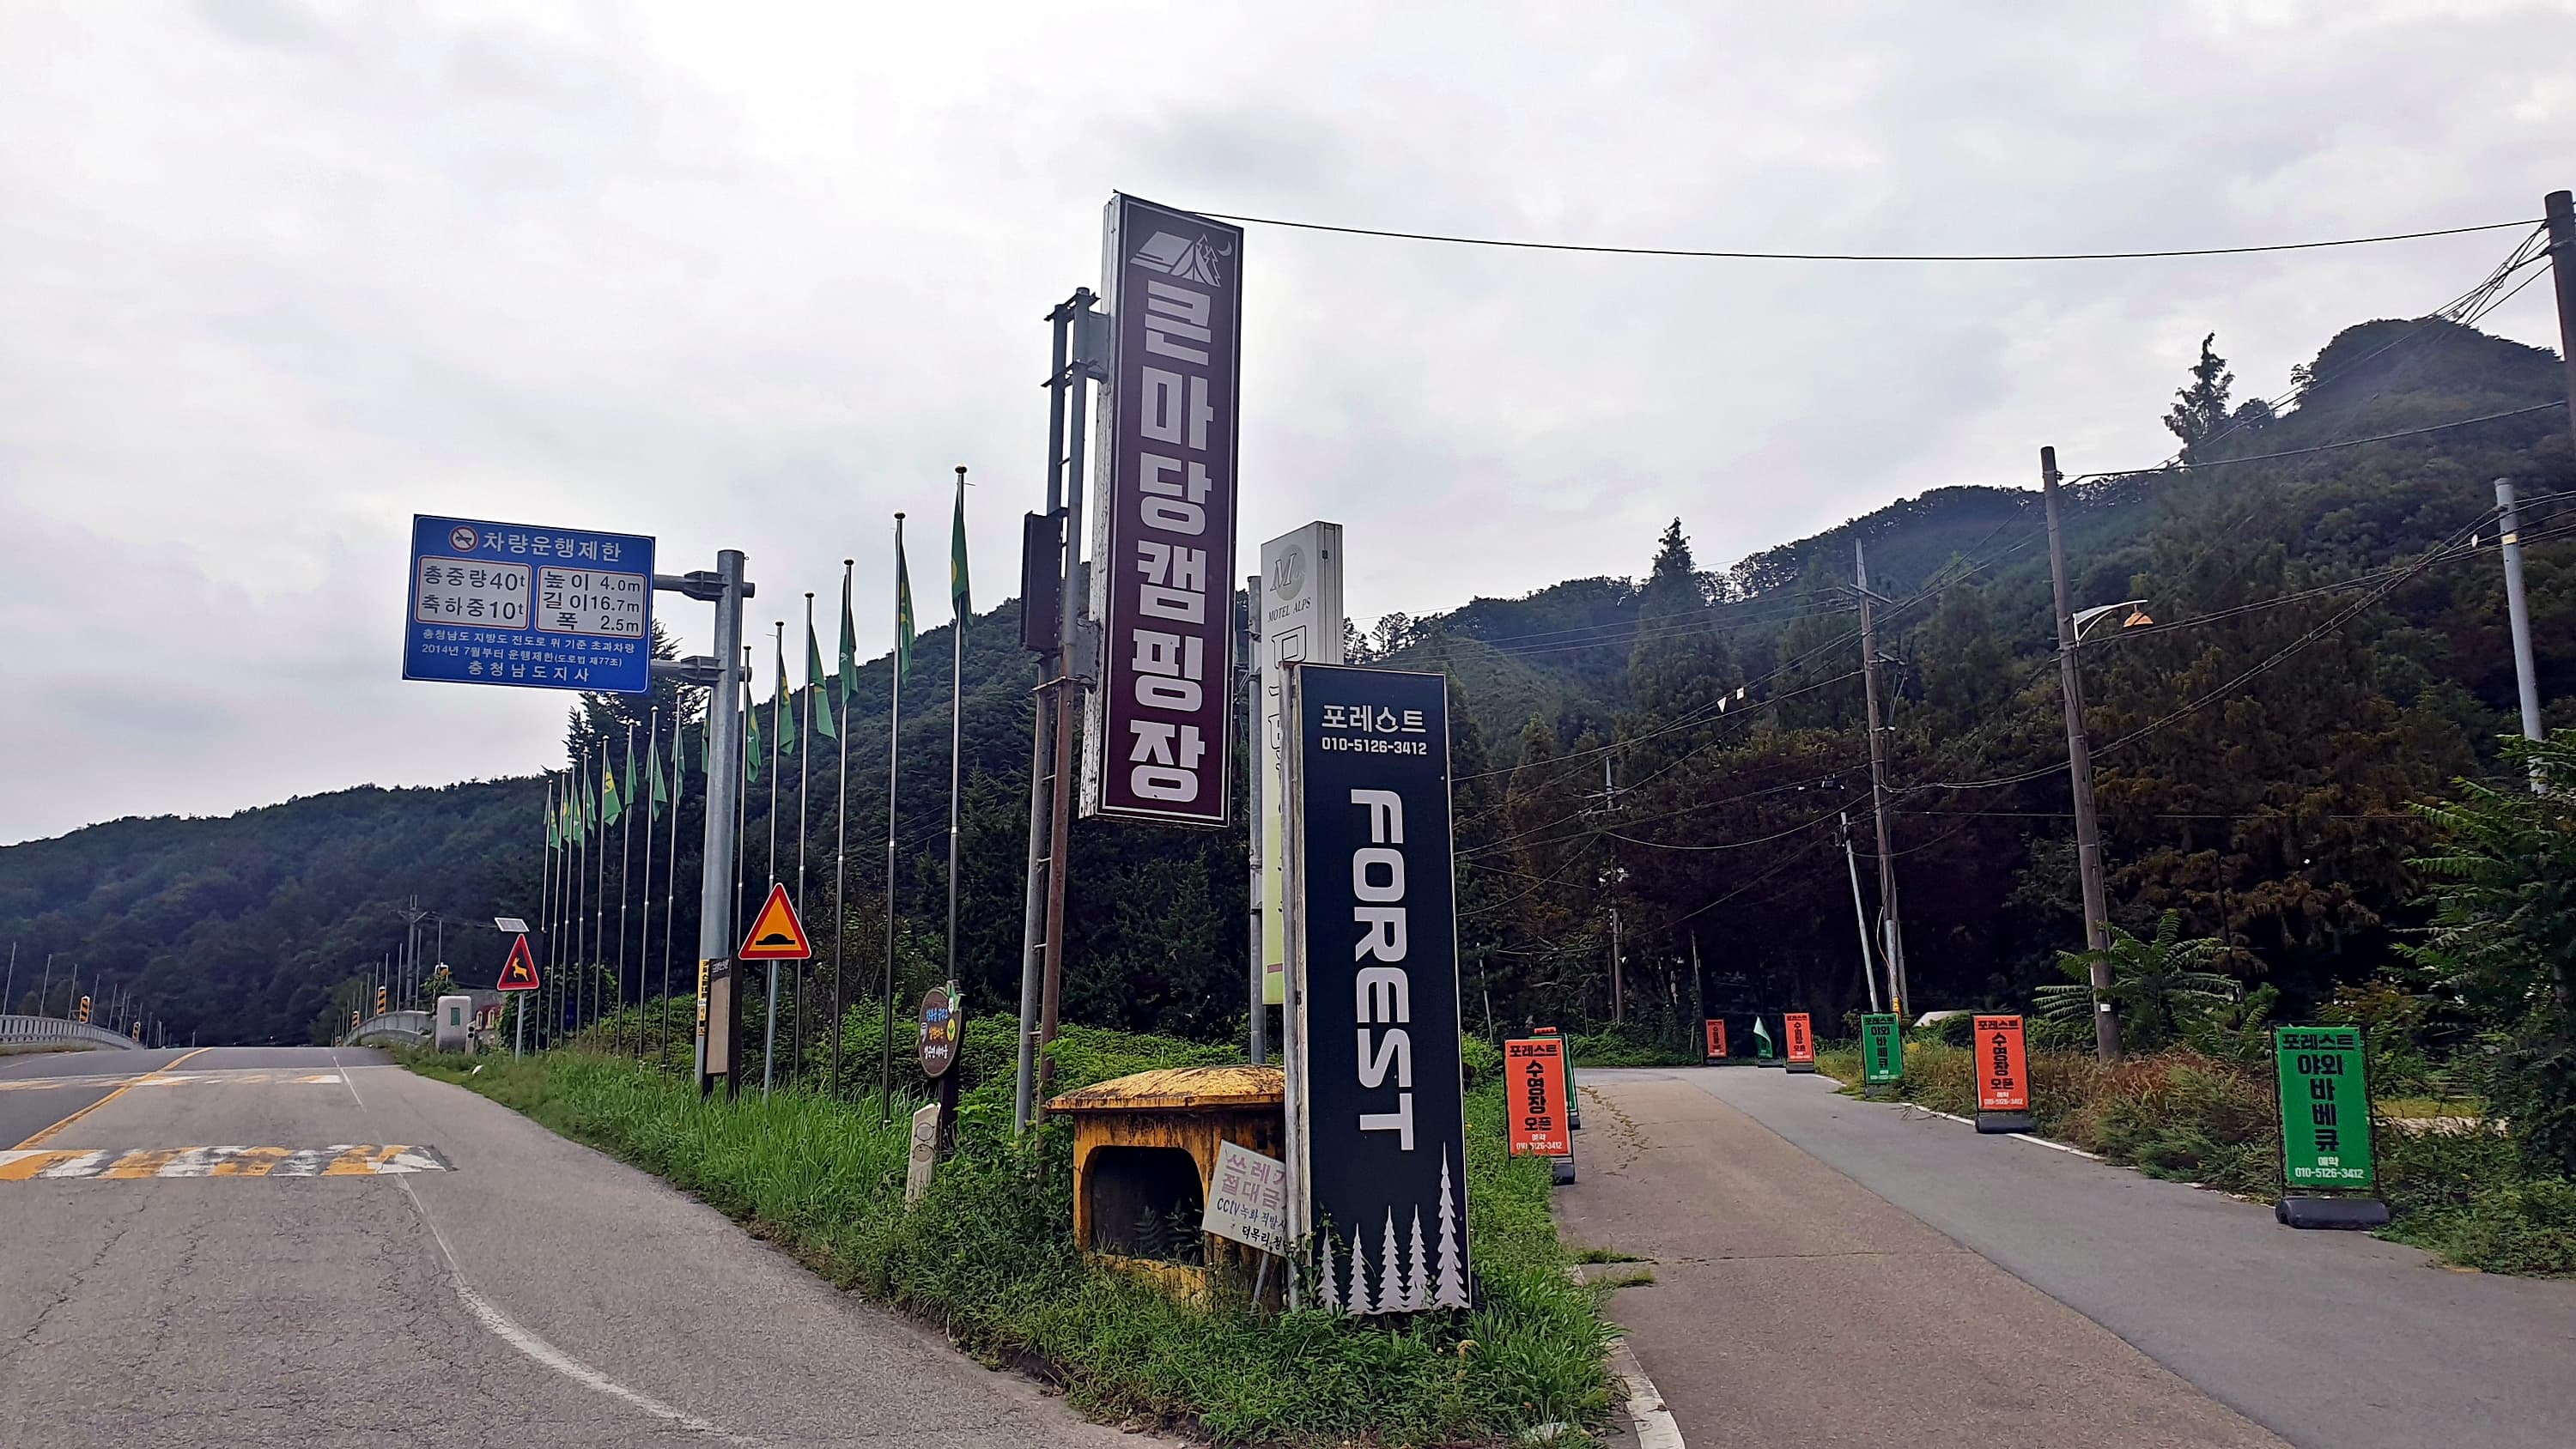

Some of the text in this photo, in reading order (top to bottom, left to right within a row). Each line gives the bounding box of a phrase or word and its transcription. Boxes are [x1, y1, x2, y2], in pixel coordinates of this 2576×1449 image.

[544, 571, 640, 592] 높이 4.0m
[1267, 597, 1311, 622] MOTEL ALPS
[556, 612, 639, 632] 폭 2.5m
[473, 632, 508, 644] 지방도
[422, 644, 459, 657] 2014년
[1321, 705, 1427, 733] 포레스트
[1321, 737, 1427, 755] 010-5126-3412
[1351, 788, 1414, 1151] FOREST
[1978, 1020, 2020, 1030] 포레스트
[1510, 1045, 1558, 1058] 포레스트
[2282, 1034, 2355, 1051] 포레스트
[2297, 1054, 2344, 1076] 야외
[1526, 1059, 1546, 1114] 수영장
[1524, 1116, 1552, 1131] 오픈
[2309, 1077, 2340, 1152] 바베큐
[2294, 1167, 2364, 1179] 010-5126-3412
[1221, 1173, 1287, 1210] 절대금
